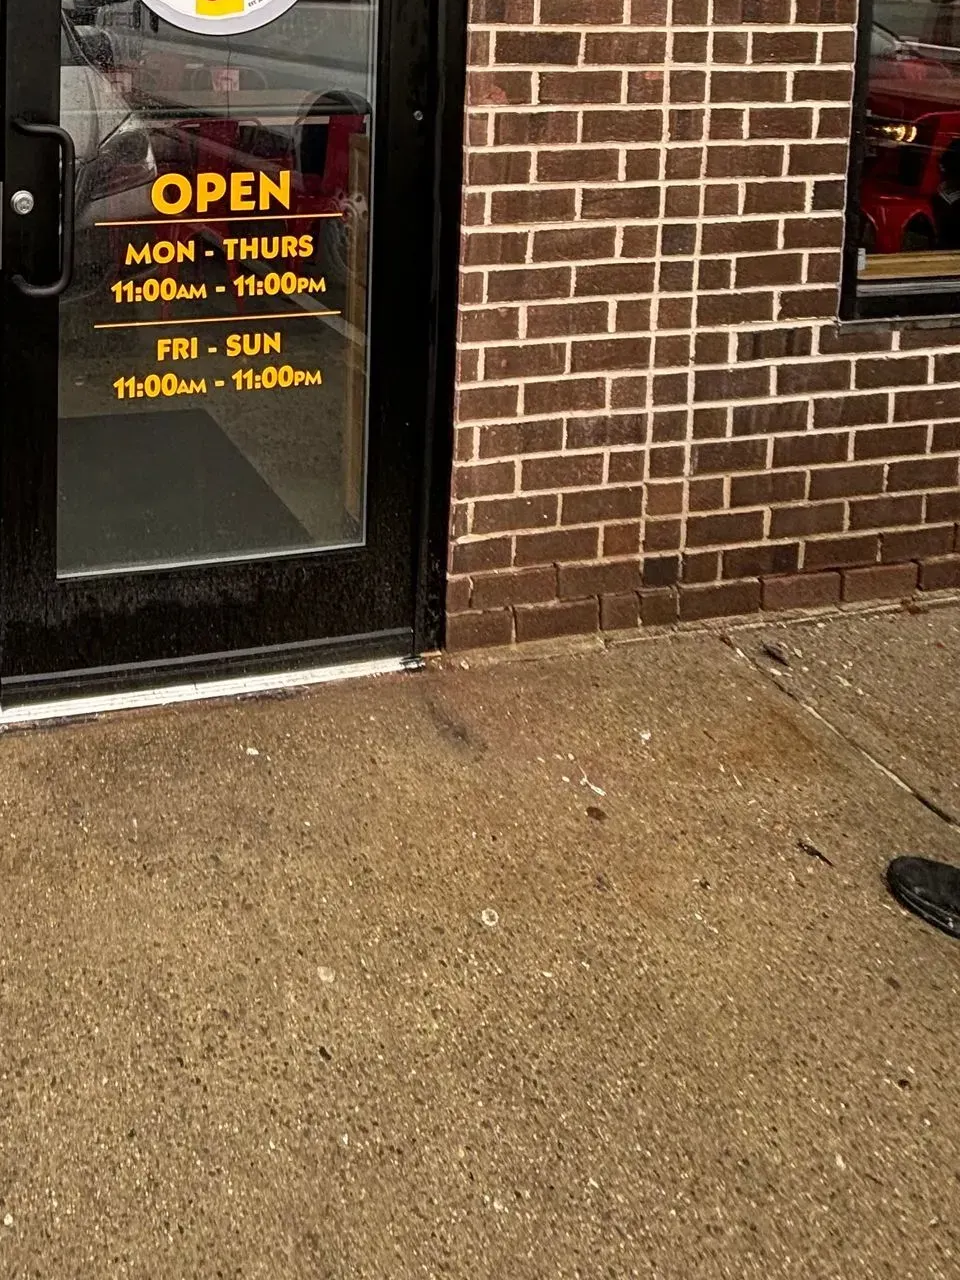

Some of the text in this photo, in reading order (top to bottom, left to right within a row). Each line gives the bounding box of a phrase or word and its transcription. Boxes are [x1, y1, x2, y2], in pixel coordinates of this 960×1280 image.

[151, 170, 292, 215] OPEN
[125, 240, 195, 266] MON
[223, 235, 314, 261] THURS
[111, 278, 207, 303] 11:00AM
[233, 272, 327, 297] 11:00PM
[157, 337, 198, 361] FRI
[226, 332, 281, 357] SUN
[113, 373, 207, 399] 11:00AM
[232, 365, 322, 391] 11:00PM
